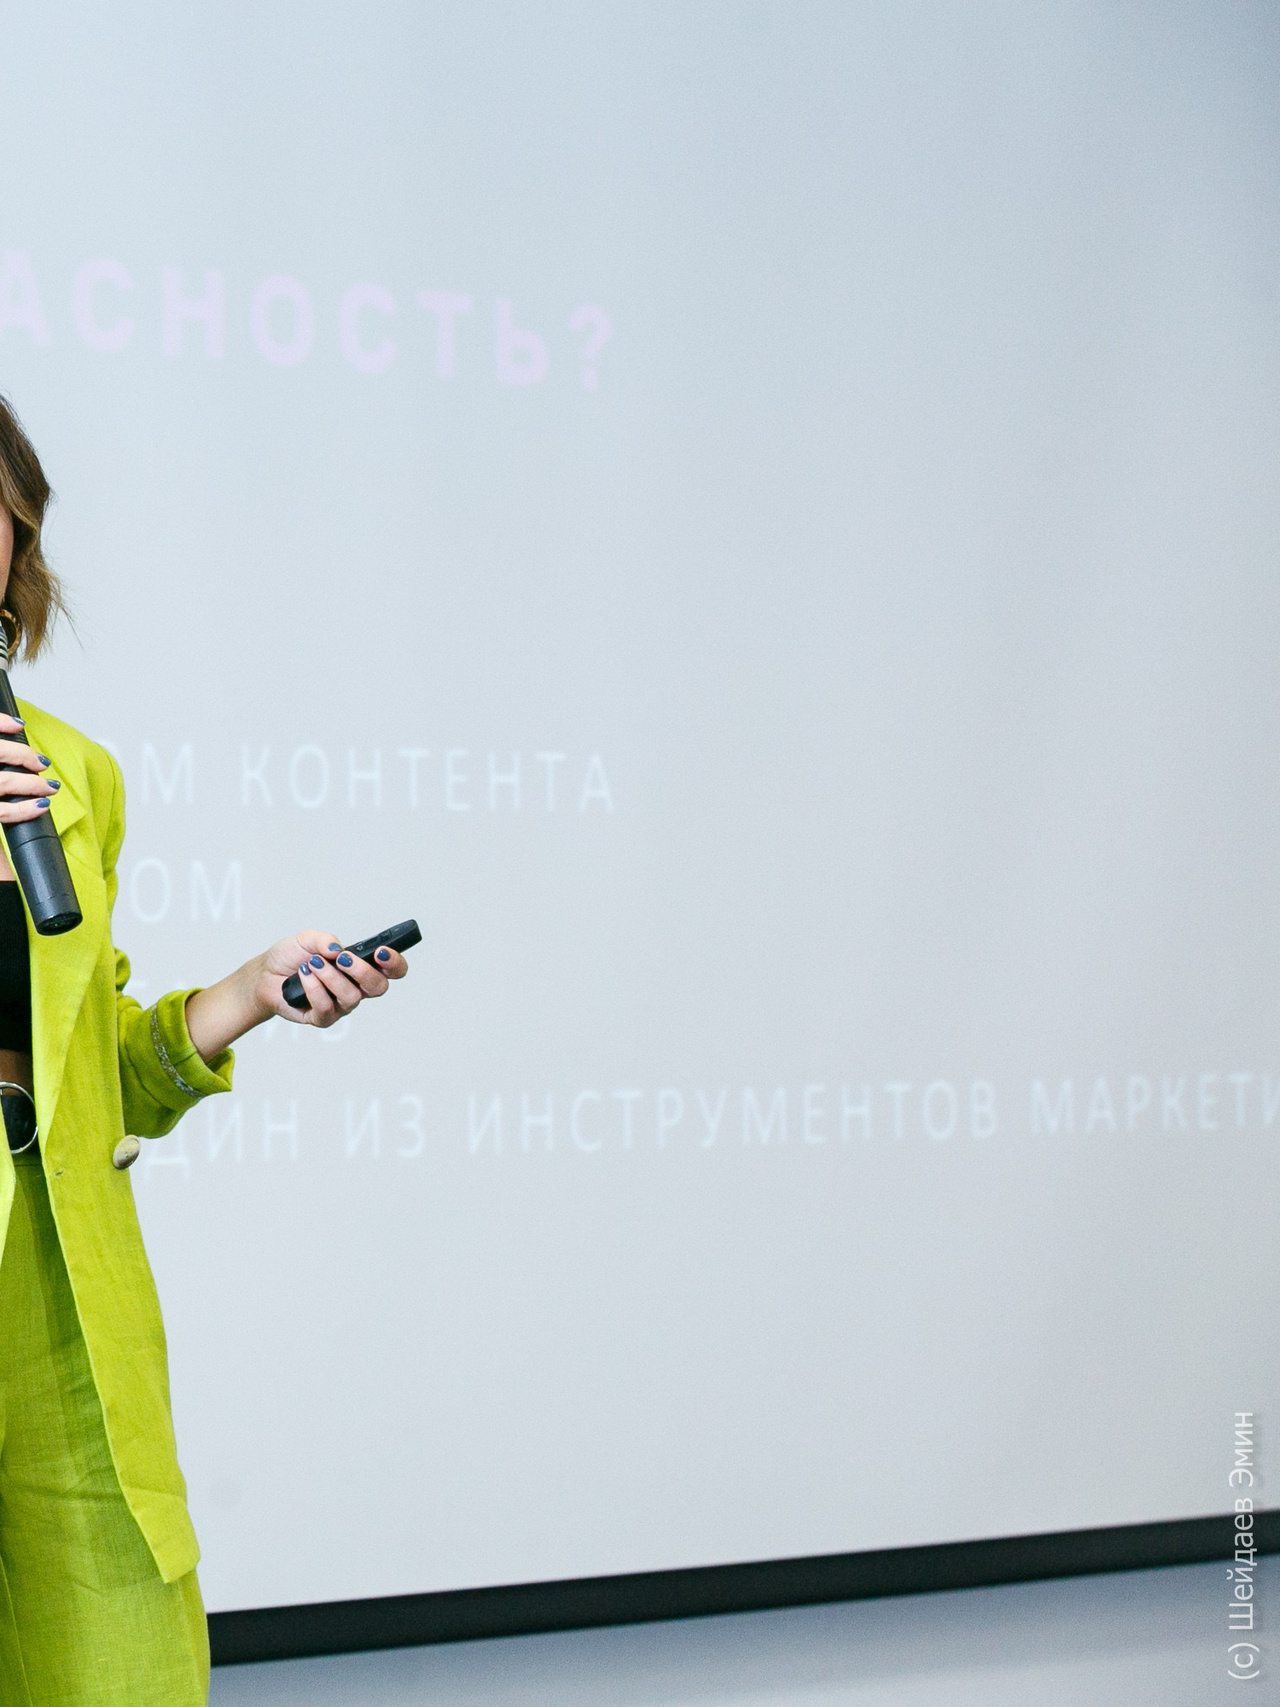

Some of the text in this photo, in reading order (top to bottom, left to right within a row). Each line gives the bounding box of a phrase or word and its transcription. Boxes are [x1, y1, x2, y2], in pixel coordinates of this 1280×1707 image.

[240, 743, 615, 815] КОНТЕНТА
[345, 1093, 425, 1160] ИЗ
[468, 1078, 1000, 1156] ИНСТРУМЕНТОВ
